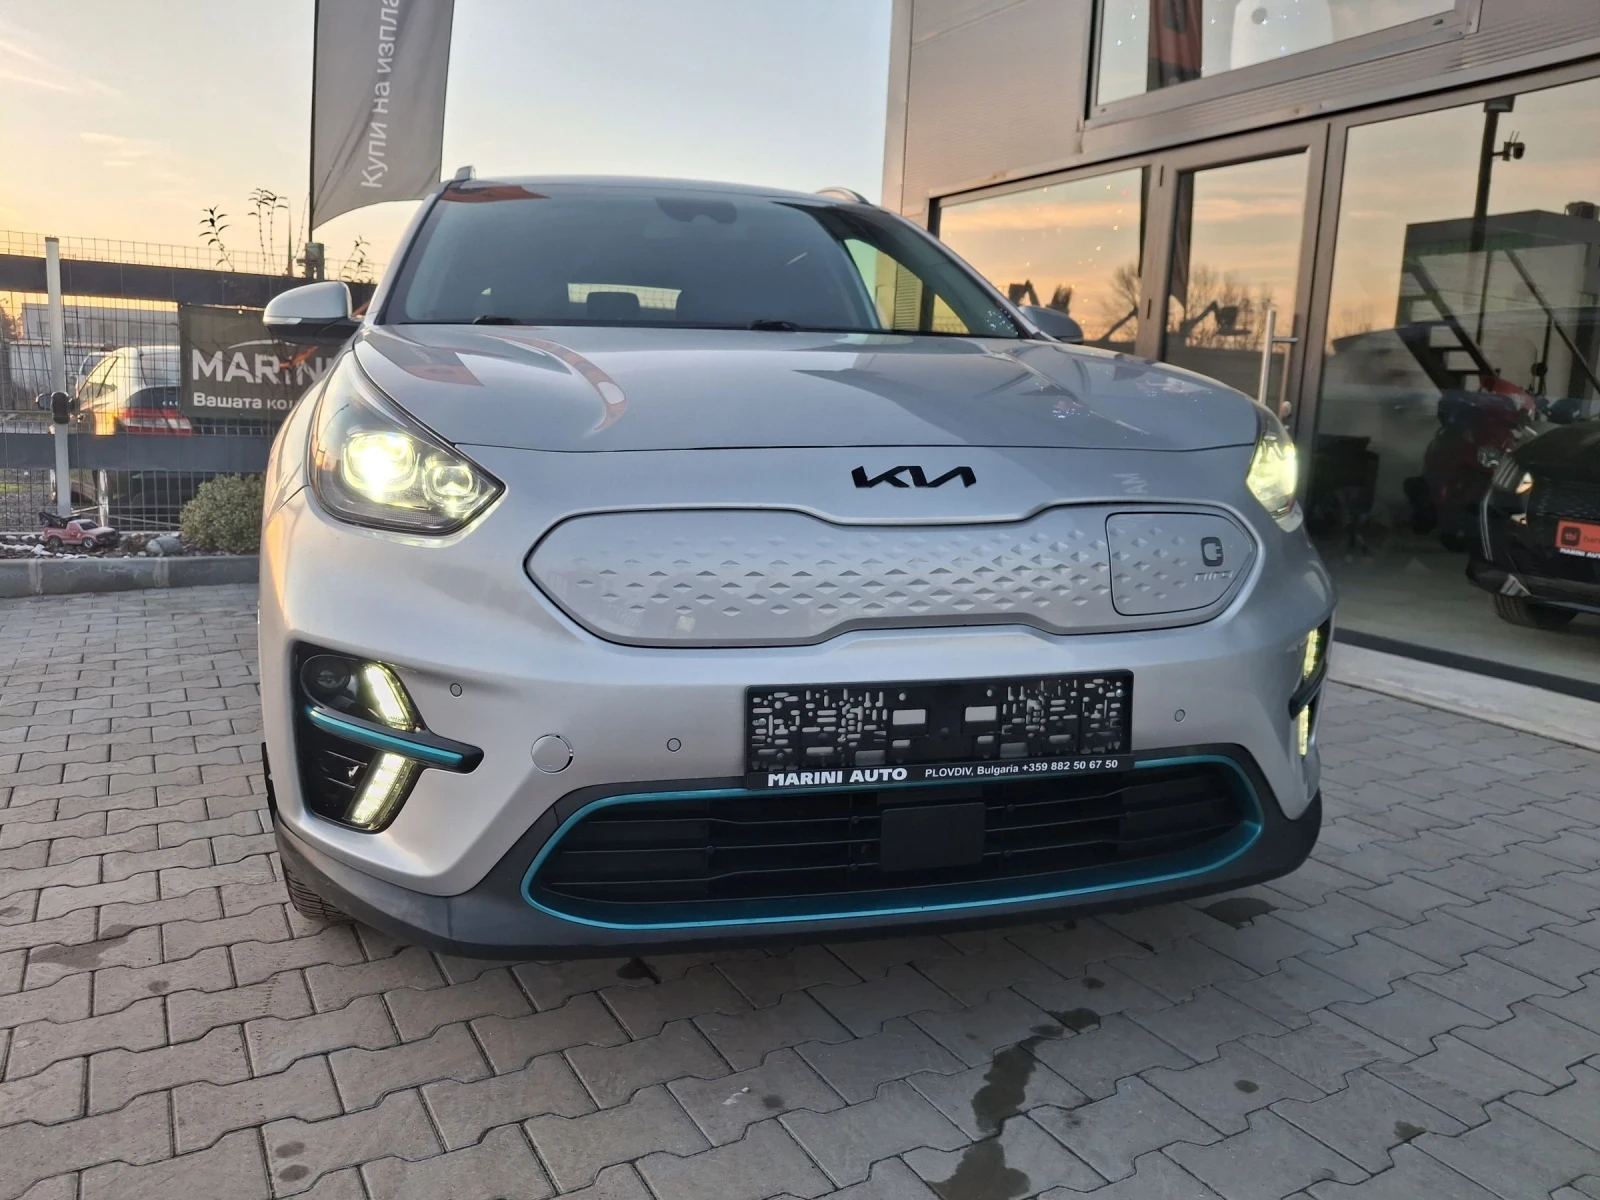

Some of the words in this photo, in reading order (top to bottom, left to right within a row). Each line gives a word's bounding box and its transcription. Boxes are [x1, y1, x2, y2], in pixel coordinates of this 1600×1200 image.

[372, 82, 391, 113] на
[361, 121, 388, 188] Купи
[193, 392, 262, 409] Вашата
[767, 770, 843, 787] MARINI
[849, 767, 908, 783] AUTO
[925, 767, 974, 777] PLOVDIV,
[977, 764, 1019, 776] Bulgaria
[1022, 763, 1048, 772] +359
[1051, 761, 1070, 771] 882
[1073, 761, 1086, 769] 50
[1089, 760, 1102, 769] 67
[1105, 760, 1118, 769] 50
